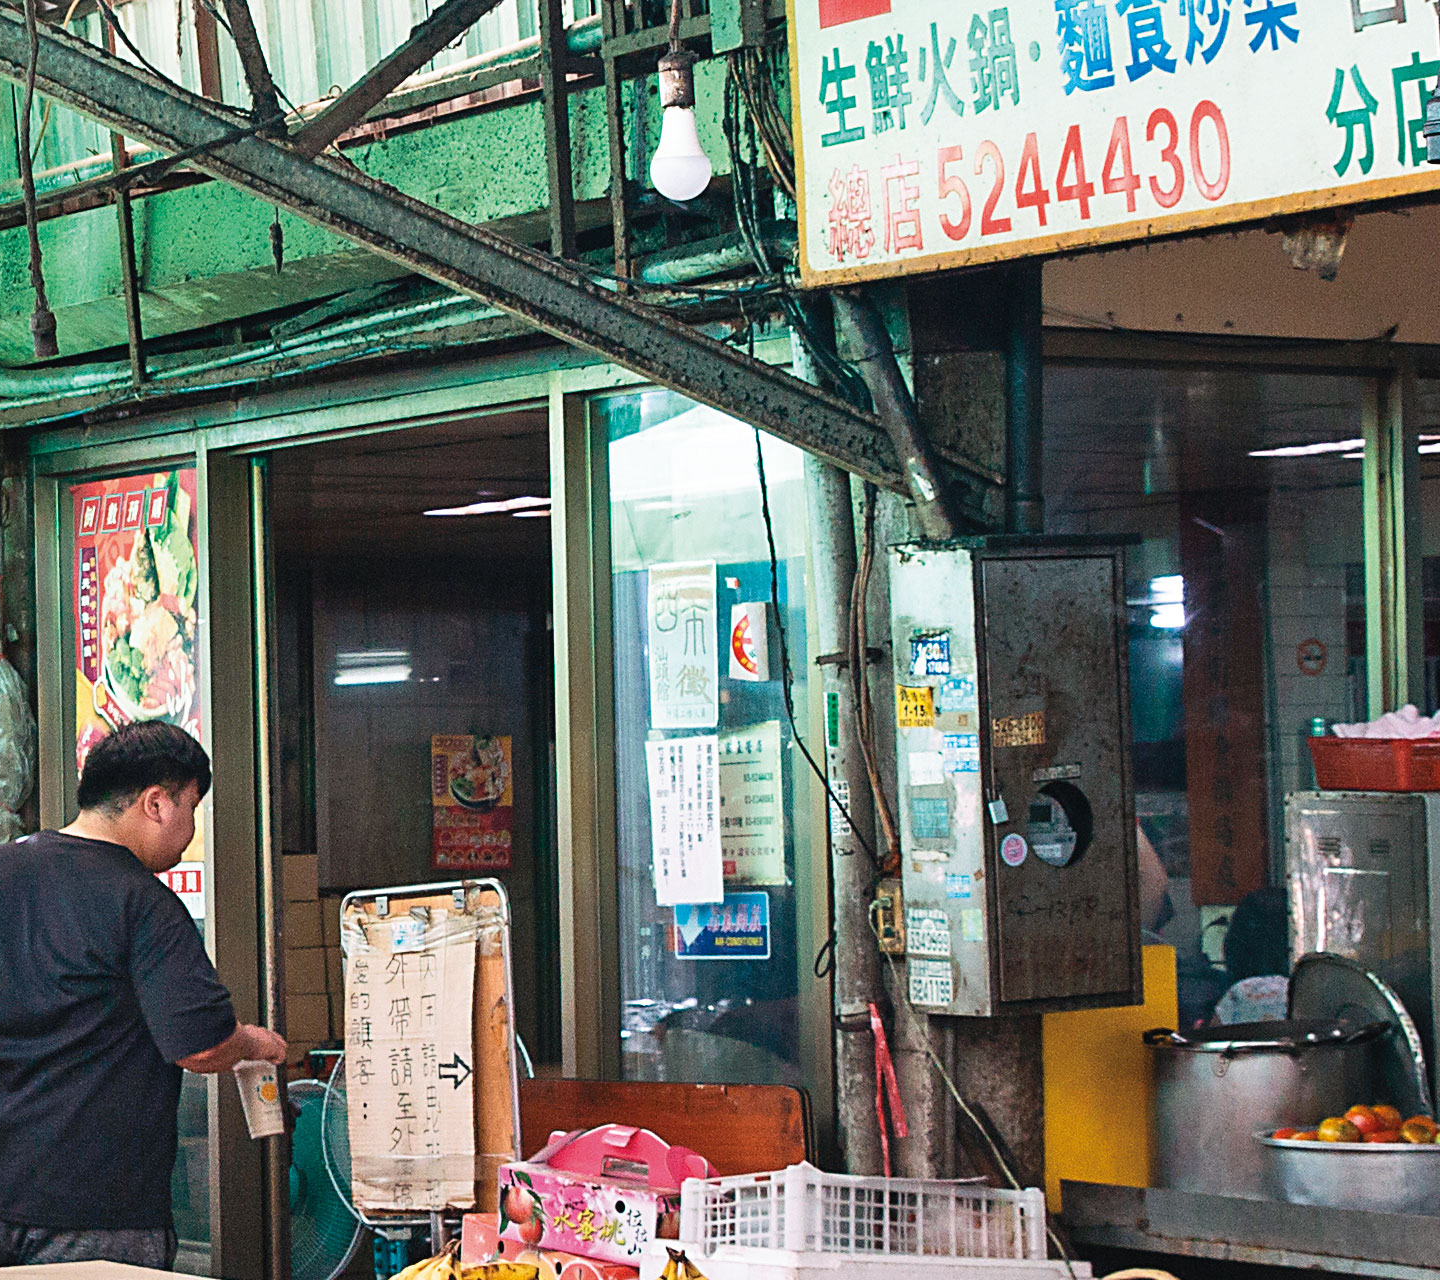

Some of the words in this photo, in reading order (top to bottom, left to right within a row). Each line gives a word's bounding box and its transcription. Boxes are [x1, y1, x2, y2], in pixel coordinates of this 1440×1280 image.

[553, 1209, 626, 1245] 水蜜桃
[627, 1208, 648, 1255] 拉拉山
